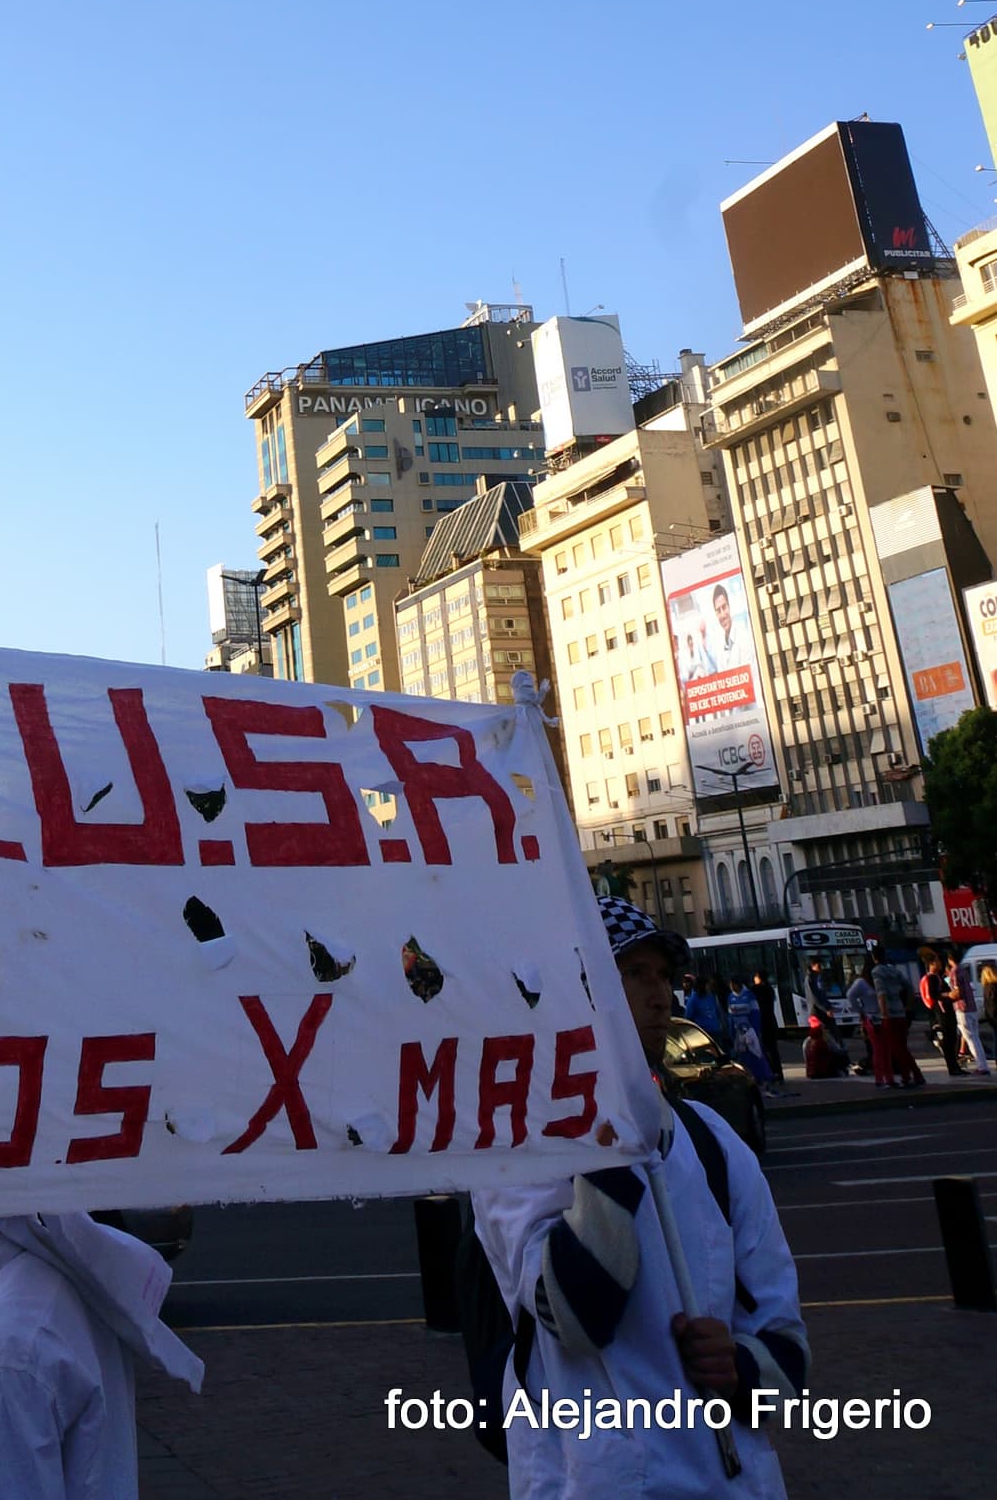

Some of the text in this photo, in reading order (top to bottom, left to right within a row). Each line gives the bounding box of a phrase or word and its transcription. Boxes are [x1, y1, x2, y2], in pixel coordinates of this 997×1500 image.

[590, 366, 622, 375] Accord
[591, 374, 616, 382] Salud
[979, 595, 997, 618] CO
[725, 672, 750, 688] SUELDO
[718, 744, 747, 767] ICBC
[803, 932, 830, 945] 9
[222, 993, 333, 1155] X
[388, 1024, 599, 1155] MAS
